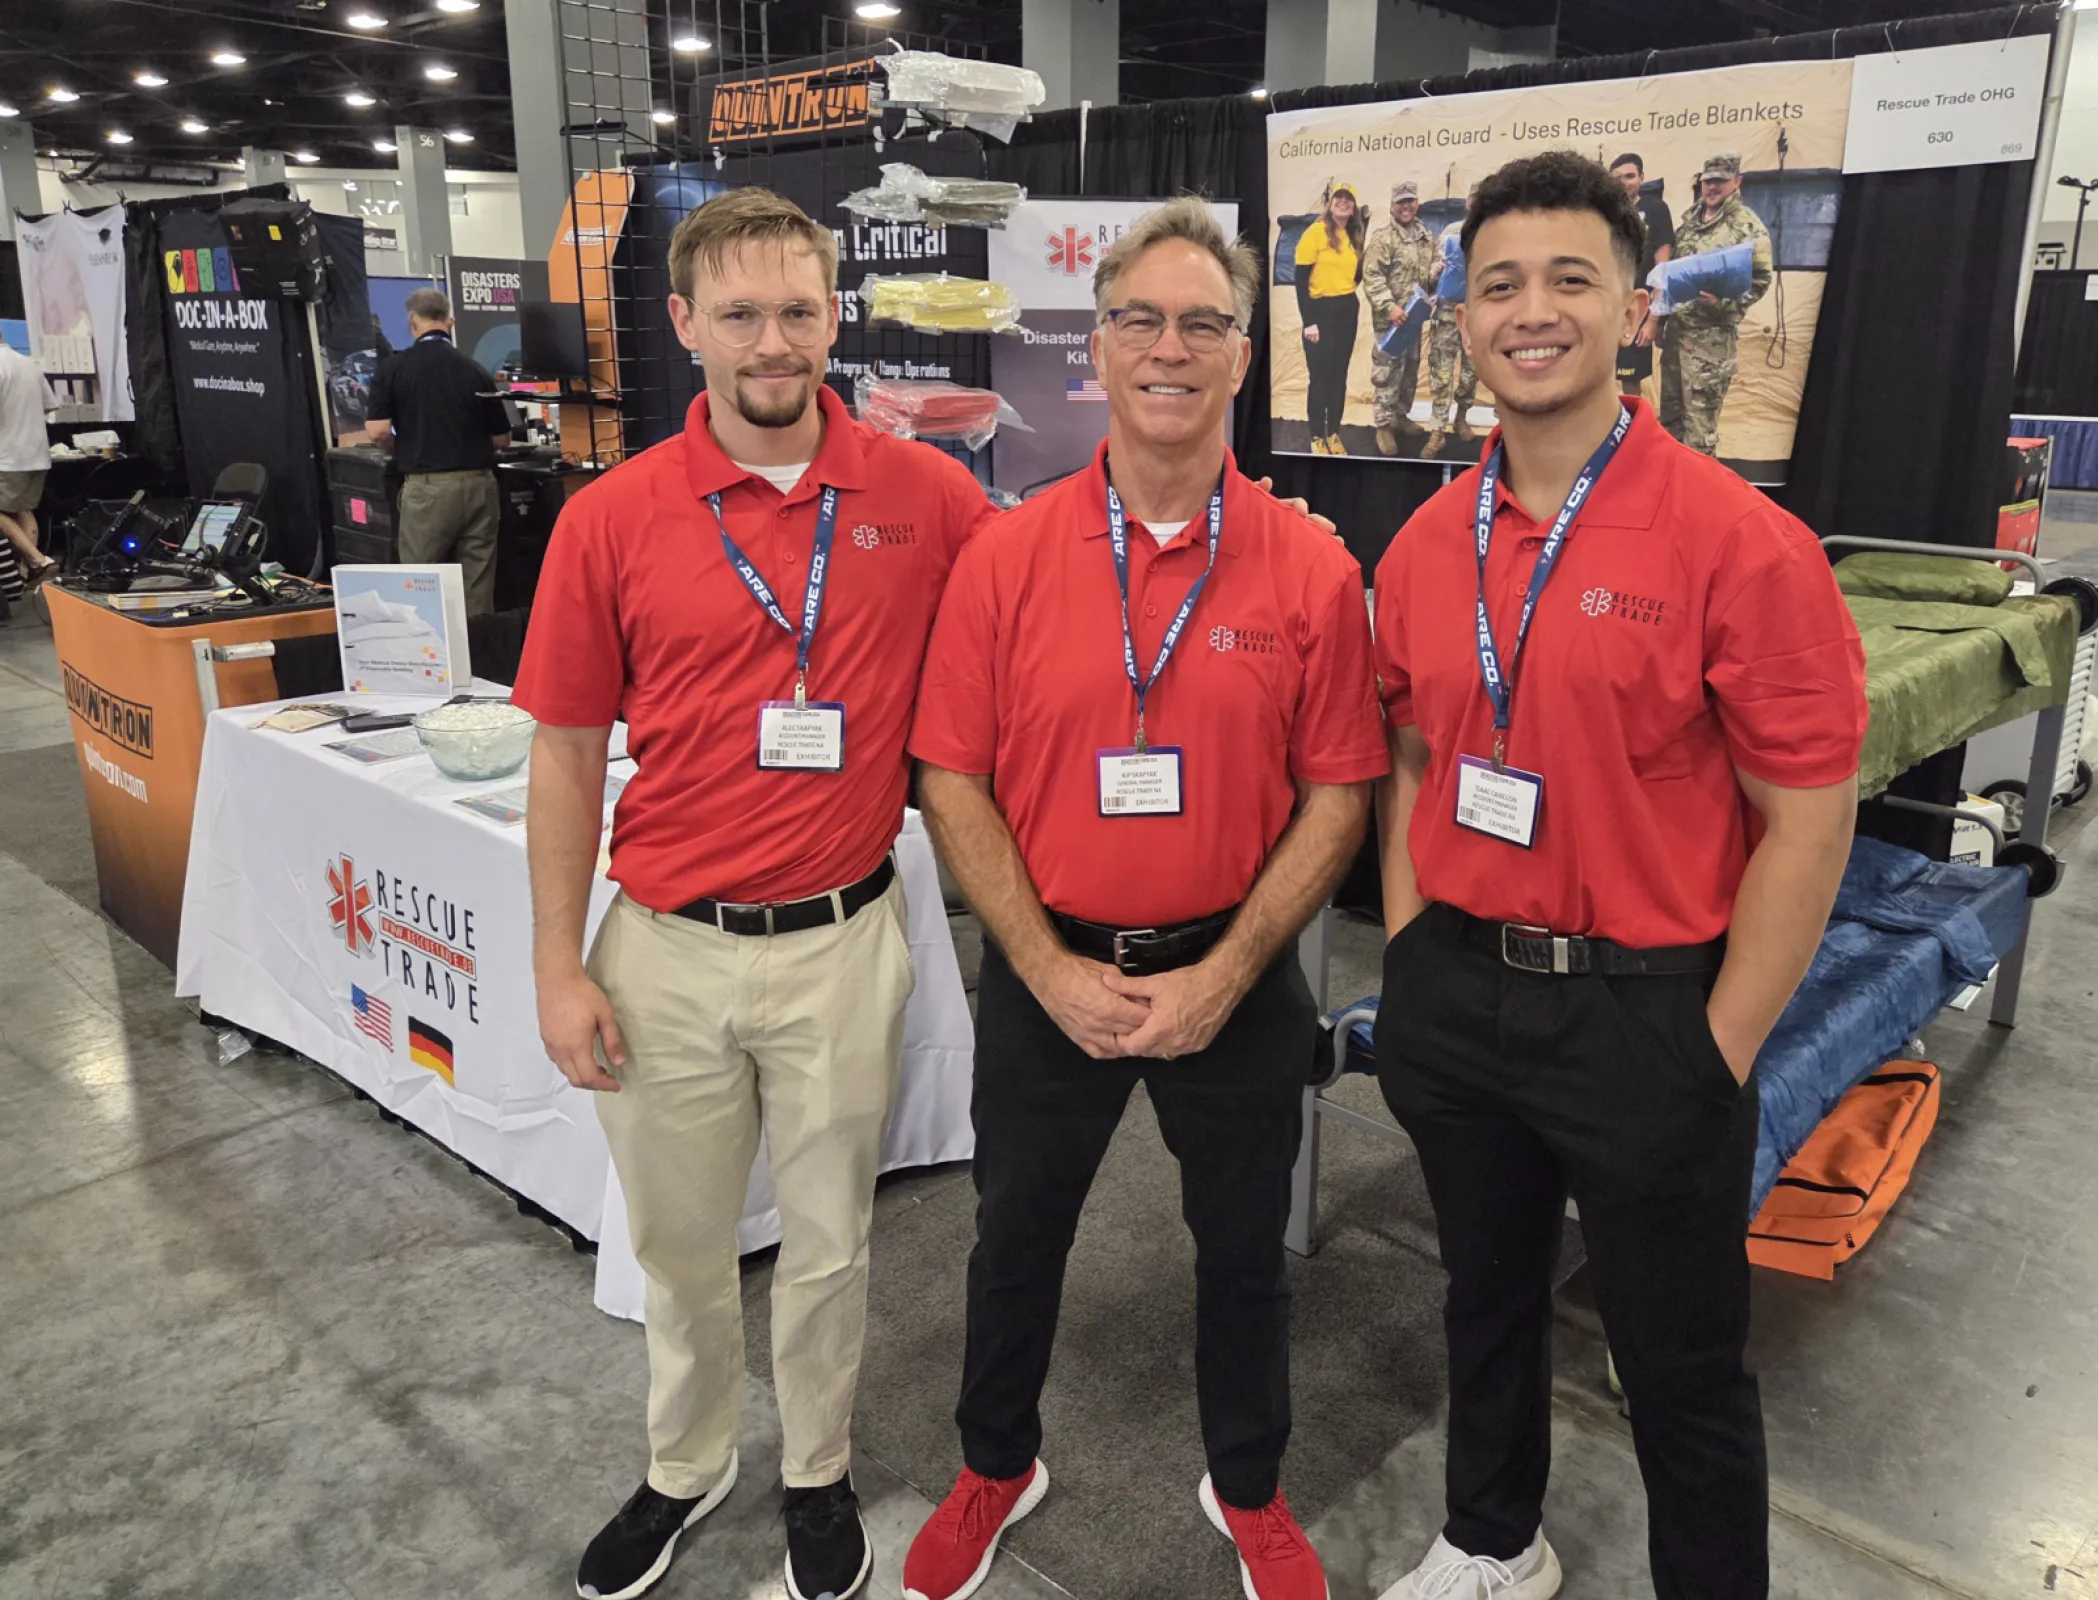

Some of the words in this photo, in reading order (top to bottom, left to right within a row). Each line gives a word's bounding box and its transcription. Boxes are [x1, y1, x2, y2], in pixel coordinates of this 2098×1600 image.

[1877, 98, 1930, 112] Rescue
[1935, 91, 1976, 106] Trade
[1980, 87, 2016, 102] OHG
[419, 134, 435, 148] 56
[1279, 136, 1353, 159] California
[1358, 130, 1431, 152] National
[1436, 125, 1492, 147] Guard
[1512, 121, 1560, 140] Uses
[1566, 118, 1642, 137] Rescue
[1648, 108, 1700, 131] Trade
[1706, 102, 1803, 126] Blankets
[1927, 130, 1954, 144] 630
[2000, 143, 2023, 155] 869
[853, 217, 948, 261] Critical
[461, 271, 520, 289] DISASTERS
[462, 287, 492, 303] EXPO
[493, 288, 515, 304] USA
[175, 300, 269, 330] DOC-IN-A-BOX
[1023, 331, 1089, 345] Disaster
[1067, 351, 1089, 365] Kit
[1479, 477, 1493, 522] ARE
[1209, 496, 1221, 536] ARE
[877, 523, 914, 534] RESCUE
[879, 534, 916, 544] TRADE
[1109, 512, 1125, 557] ARE
[1543, 510, 1572, 557] ARE
[739, 565, 773, 604] ARE
[804, 585, 820, 631] ARE
[1612, 592, 1666, 613] RESCUE
[1165, 604, 1189, 646] ARE
[1477, 602, 1492, 648] ARE
[1610, 606, 1662, 626] TRADE
[1235, 629, 1276, 643] RESCUE
[1236, 641, 1275, 654] TRADE
[63, 668, 151, 749] QUINTRON
[796, 753, 831, 761] EXHIBITOR
[1136, 798, 1169, 806] EXHIBITOR
[1488, 819, 1521, 835] EXHIBITOR
[376, 869, 476, 951] RESCUE
[380, 939, 479, 1025] TRADE
